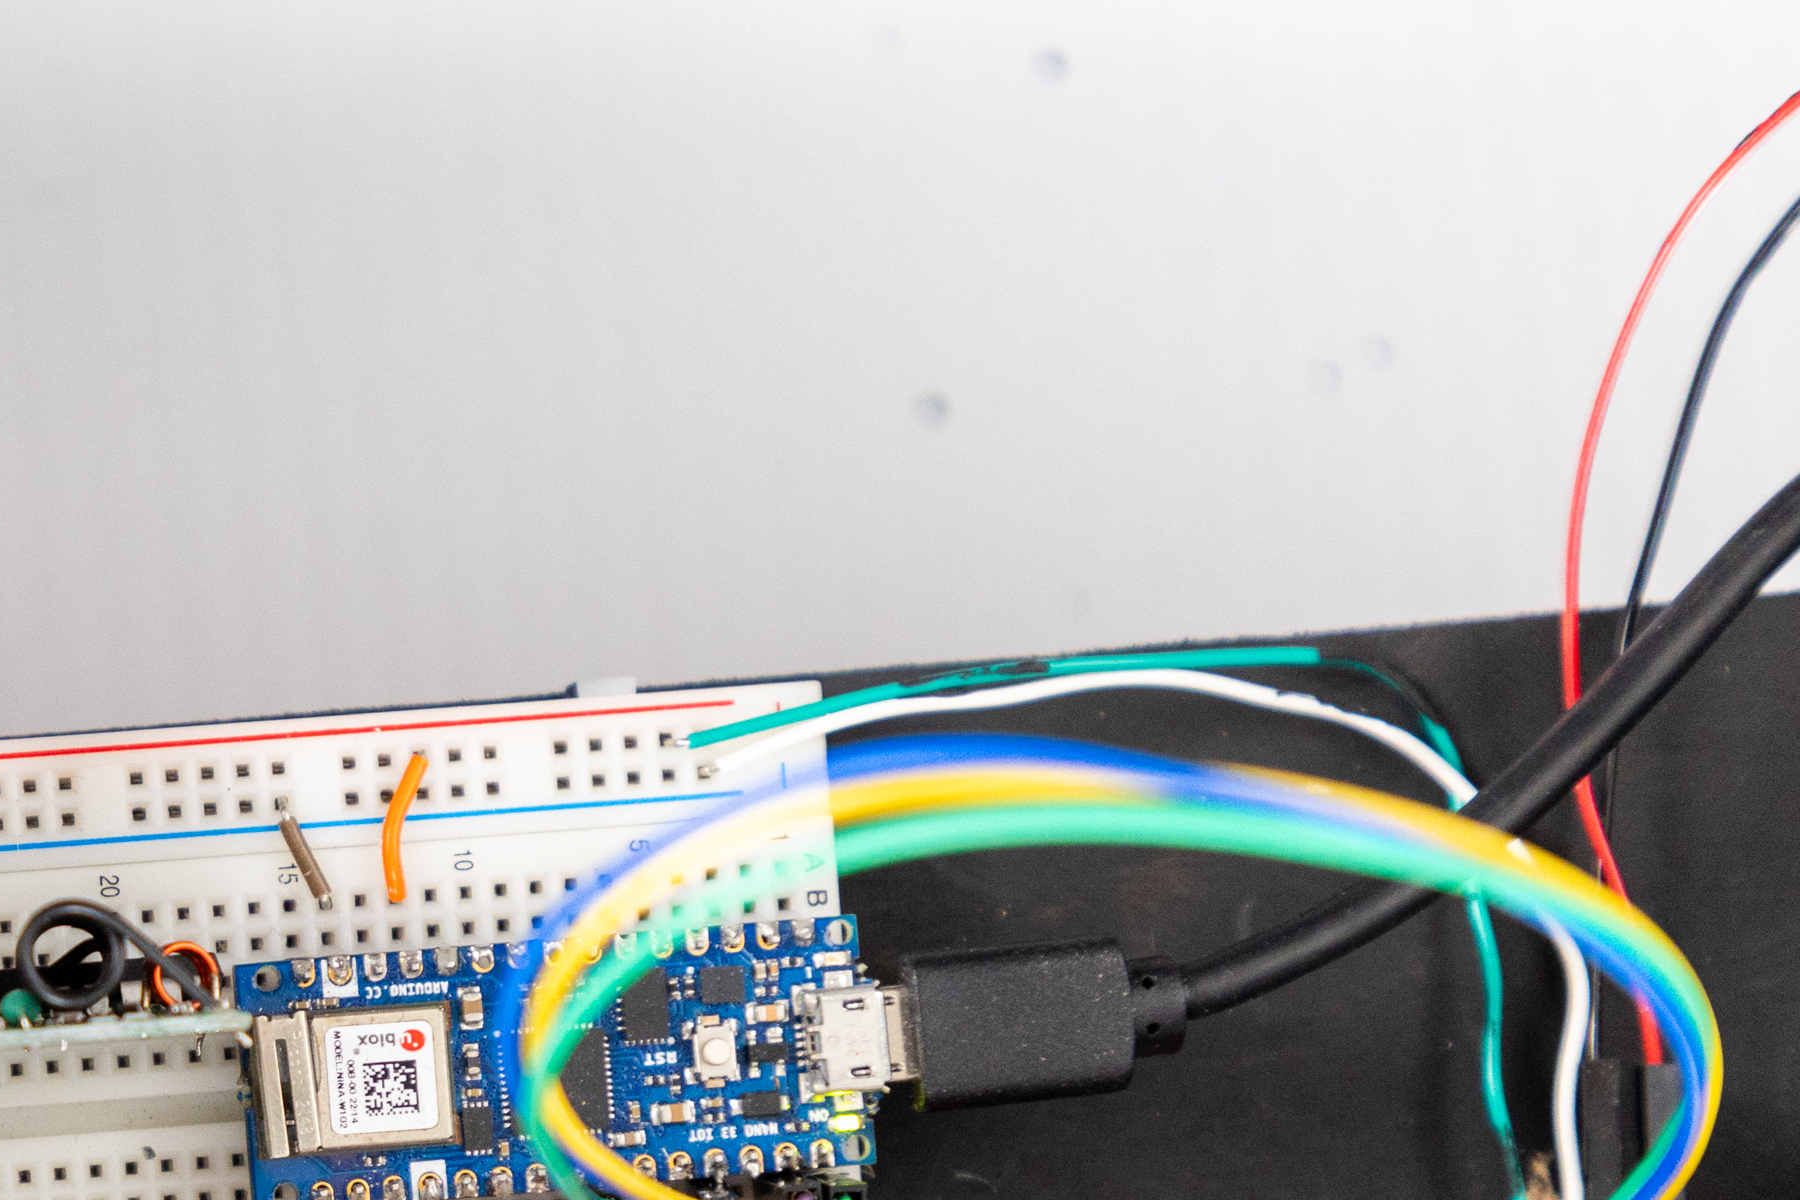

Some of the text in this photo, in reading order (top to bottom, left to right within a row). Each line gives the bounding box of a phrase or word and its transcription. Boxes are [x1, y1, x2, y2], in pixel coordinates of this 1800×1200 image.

[629, 839, 650, 852] 5
[454, 851, 473, 871] 10
[279, 863, 298, 884] 15
[100, 876, 120, 897] 20
[807, 890, 828, 907] B
[365, 980, 450, 999] ARDUINO.CC
[643, 1051, 679, 1066] RST
[807, 1109, 831, 1122] ON
[688, 1123, 779, 1143] NANO 33 IOT
